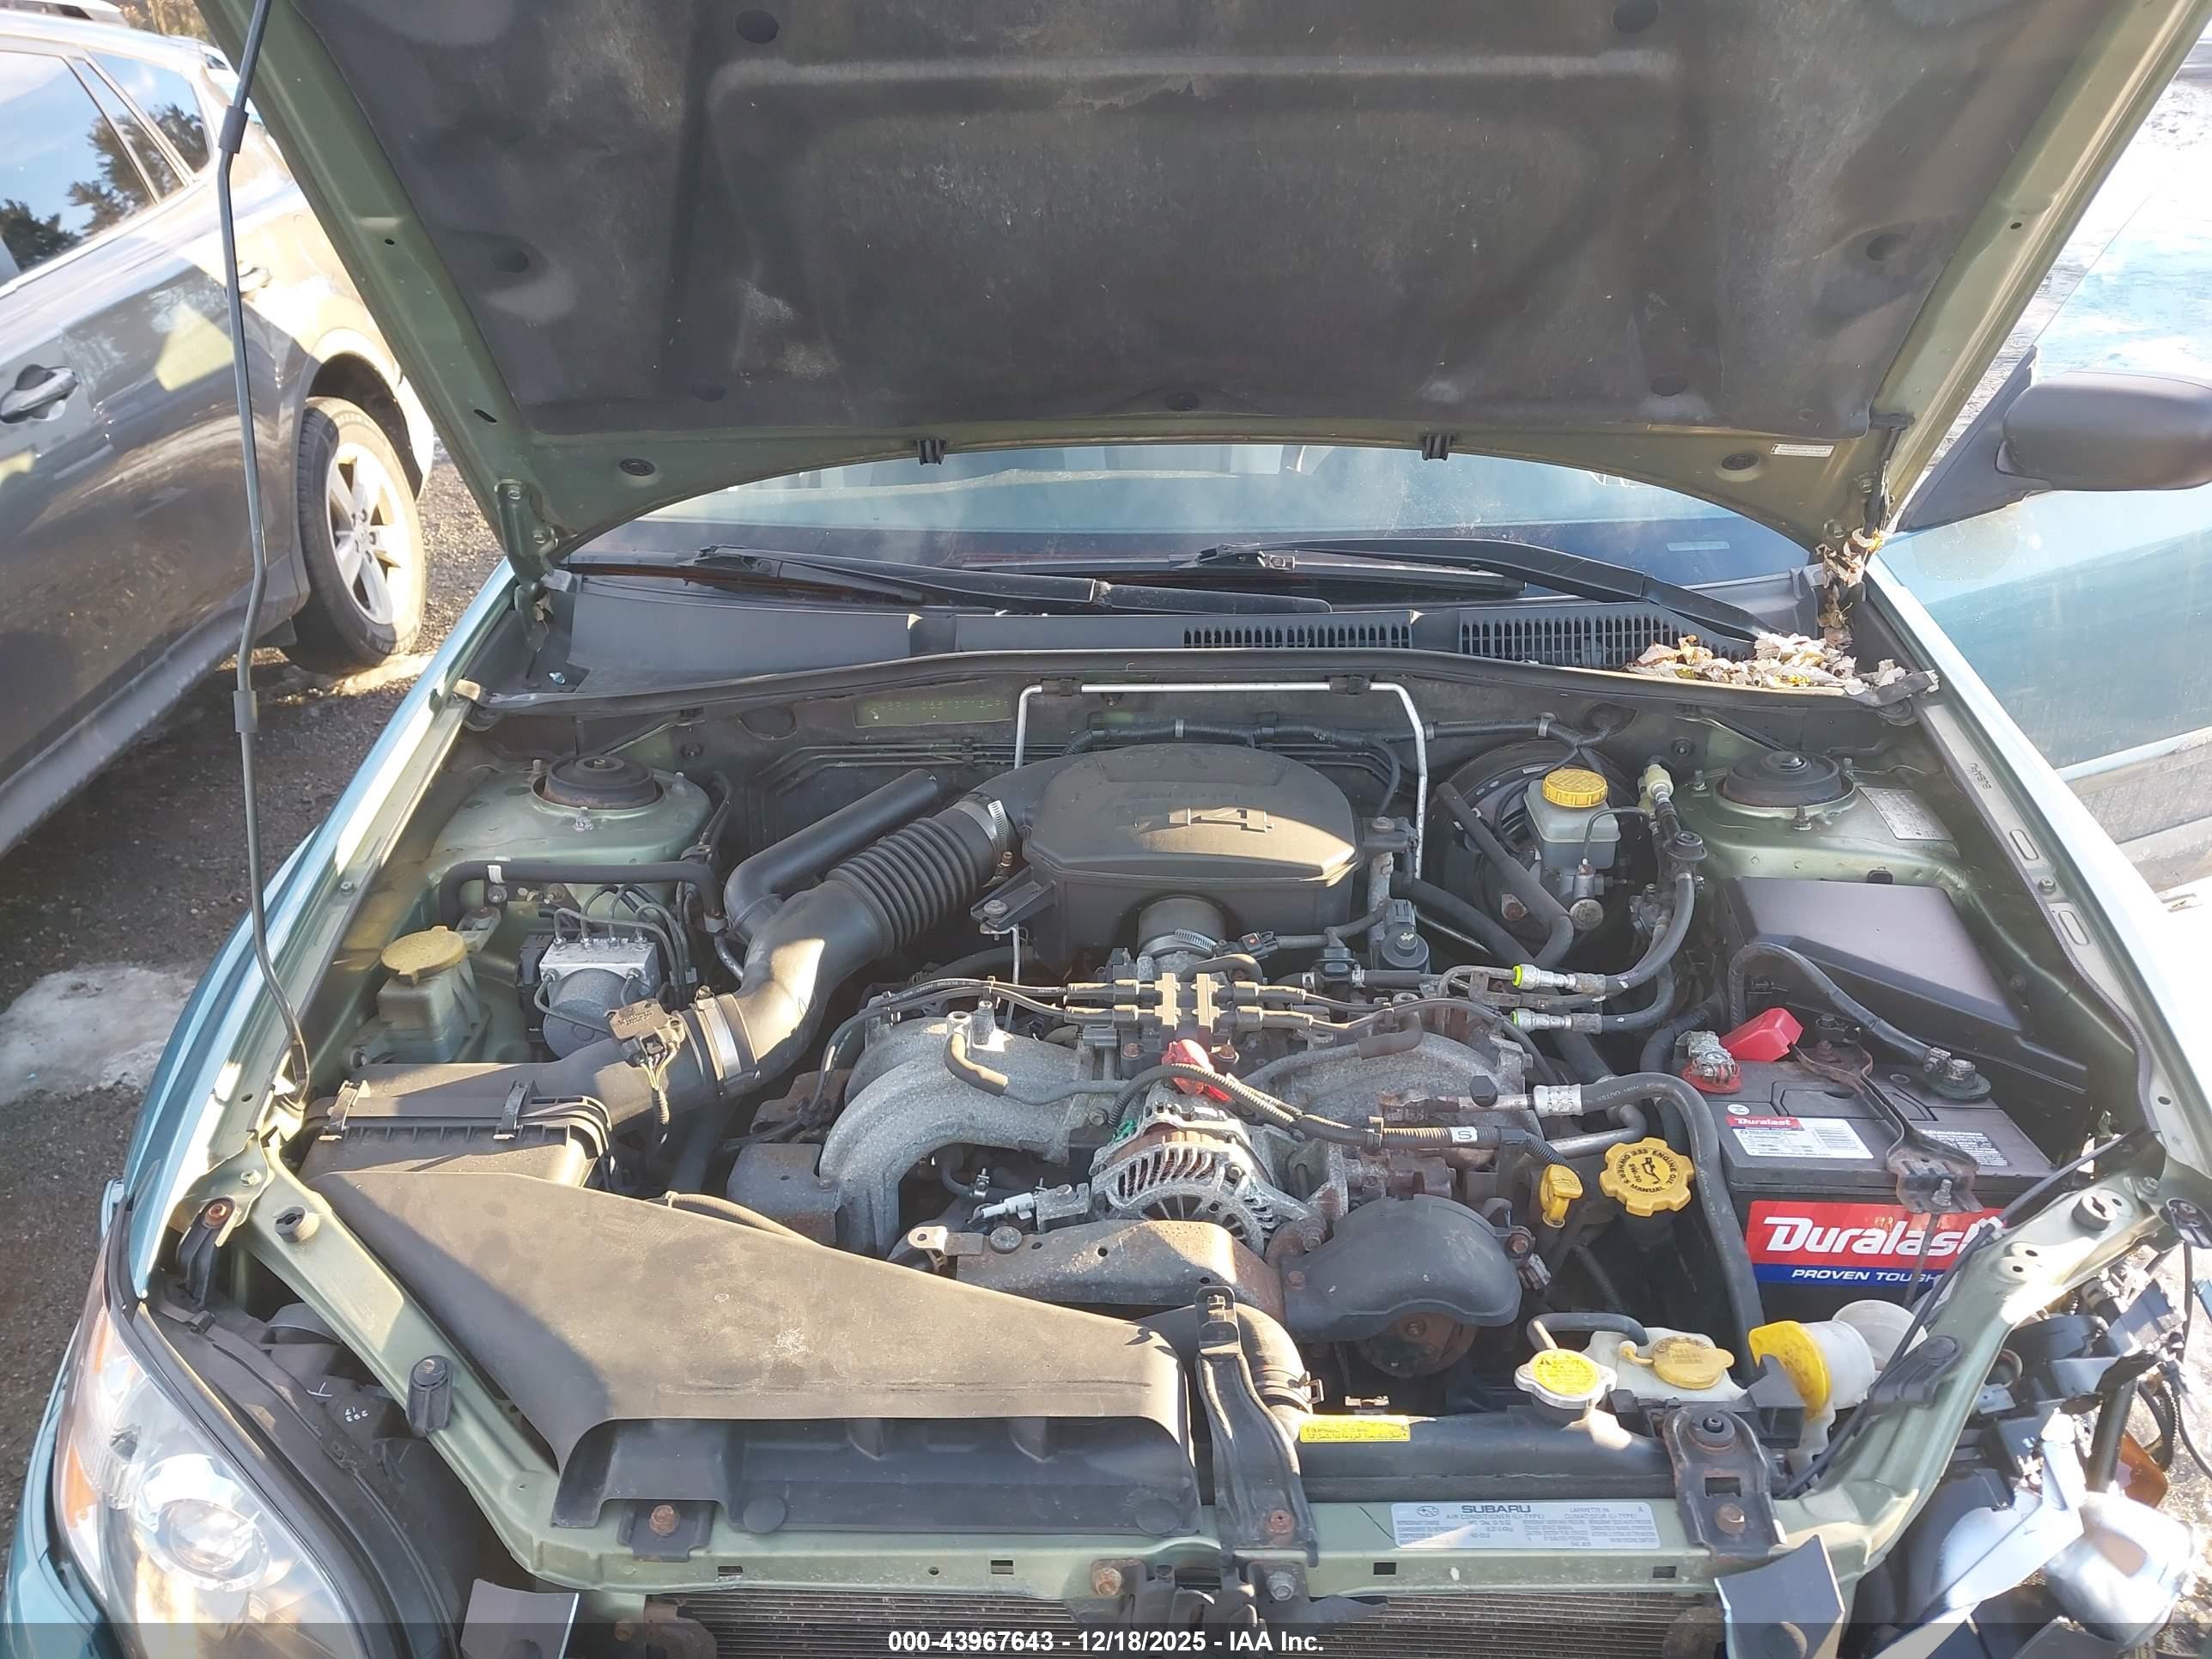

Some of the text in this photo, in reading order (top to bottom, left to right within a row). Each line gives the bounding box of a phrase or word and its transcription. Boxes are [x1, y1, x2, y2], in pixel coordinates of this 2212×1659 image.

[1735, 1117, 1792, 1126] Duralast
[1651, 1150, 1677, 1184] ENGINE OIL
[1630, 1183, 1666, 1193] MANUAL
[1791, 1268, 1869, 1281] PROVEN
[1461, 1504, 1532, 1514] SUBARU
